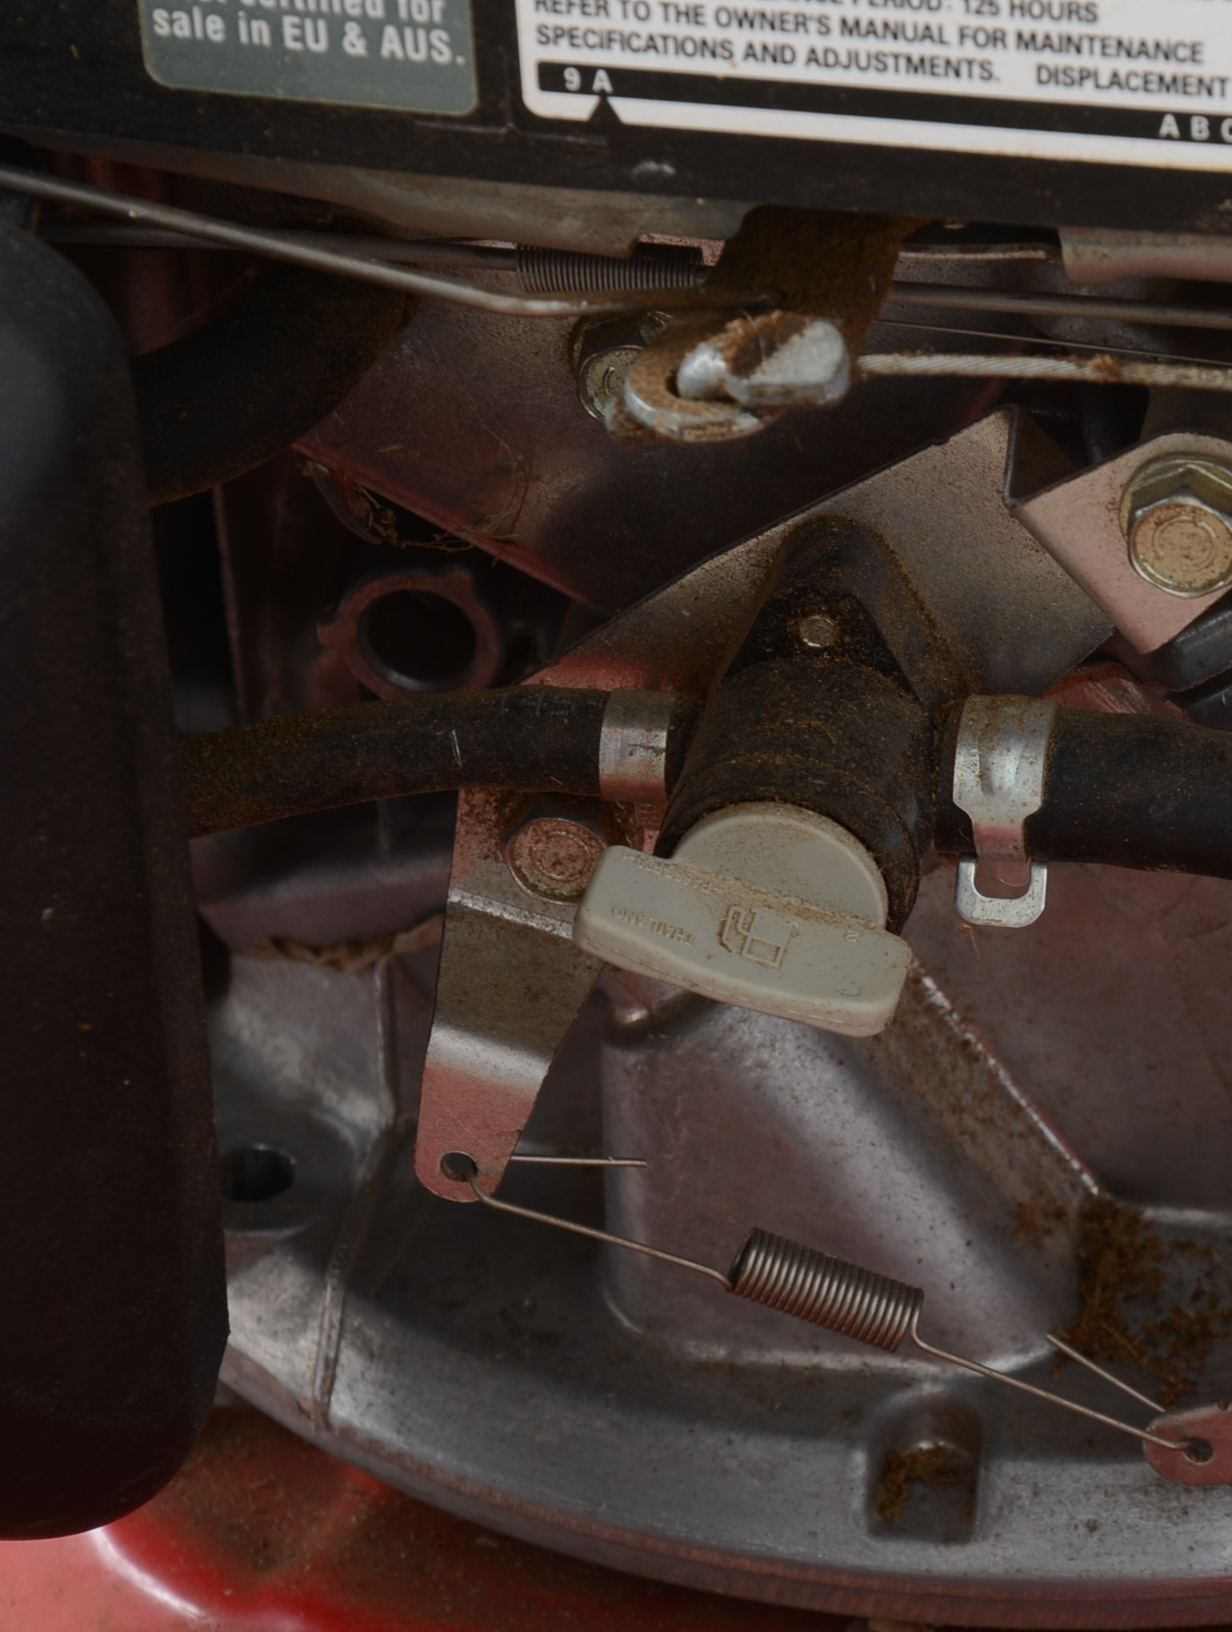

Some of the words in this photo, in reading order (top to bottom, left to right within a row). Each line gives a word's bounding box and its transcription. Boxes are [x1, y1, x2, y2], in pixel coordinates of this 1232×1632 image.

[152, 5, 225, 43] sale
[237, 10, 271, 46] in
[282, 15, 329, 53] EU
[342, 21, 368, 57] &
[380, 24, 466, 65] AUS.
[619, 0, 651, 21] TO
[658, 1, 706, 26] THE
[715, 5, 831, 36] OWNER'S
[840, 17, 950, 45] MANUAL
[959, 24, 1007, 49] FOR
[1016, 30, 1204, 64] MAINTENANCE
[1010, 0, 1099, 23] HOURS
[536, 24, 734, 61] SPECIFICATIONS
[743, 41, 797, 65] AND
[806, 46, 1001, 82] ADJUSTMENTS.
[563, 67, 581, 91] 9
[592, 69, 614, 94] A
